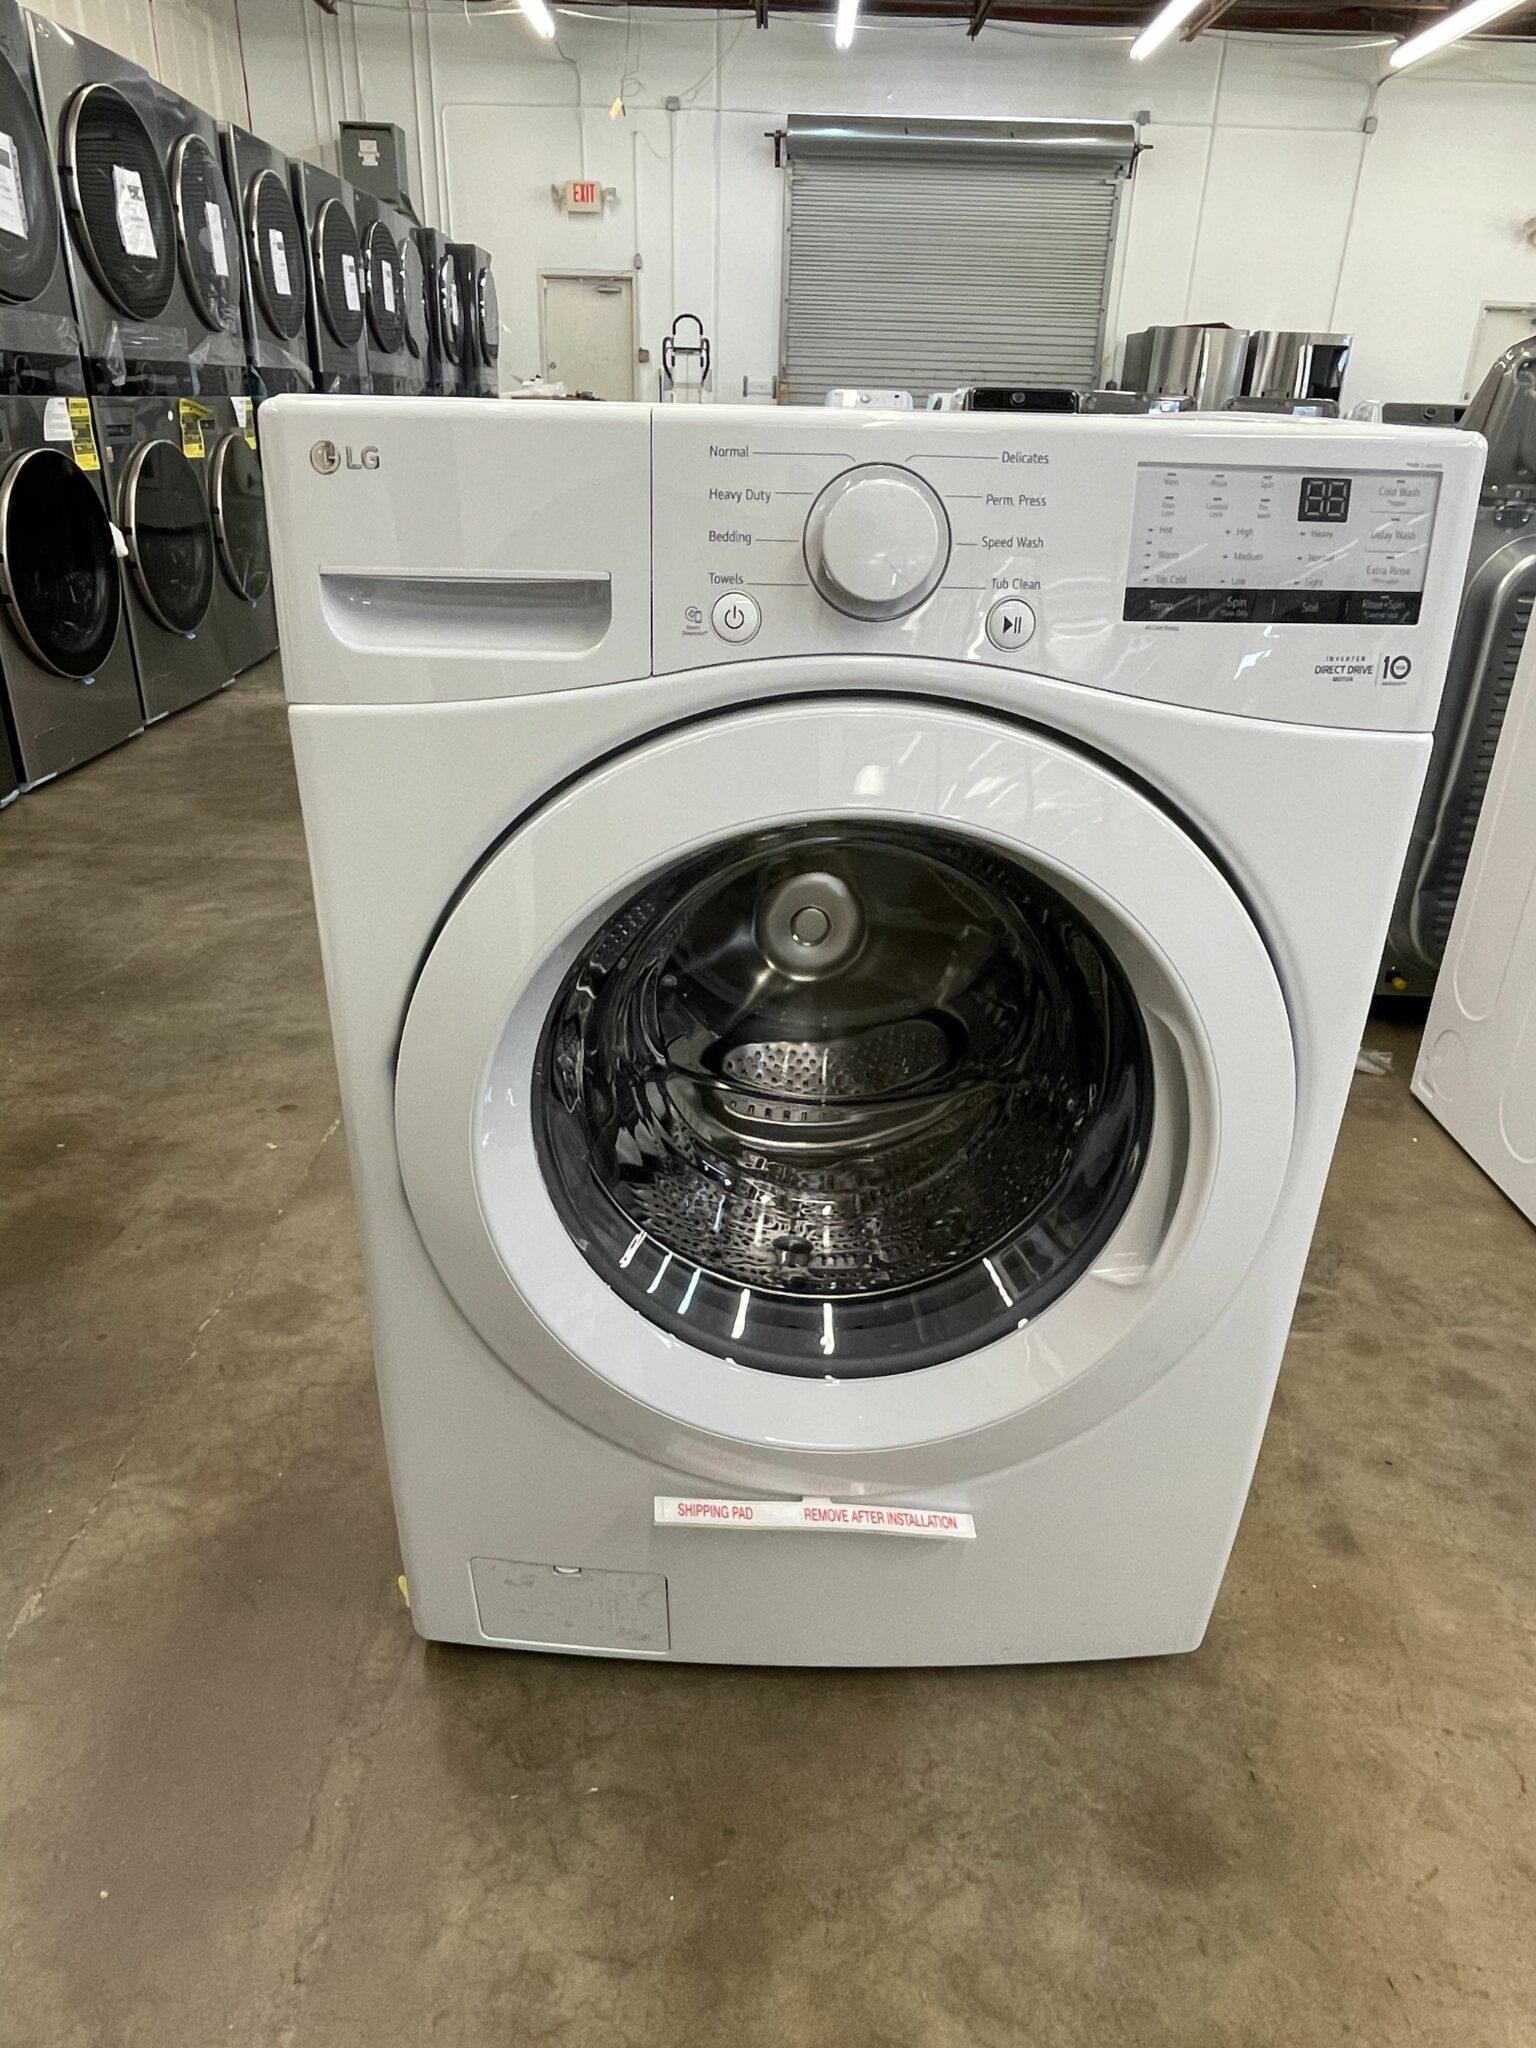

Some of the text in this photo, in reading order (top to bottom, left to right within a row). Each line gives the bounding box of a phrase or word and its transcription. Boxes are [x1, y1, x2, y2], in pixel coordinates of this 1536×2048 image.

[573, 183, 595, 203] EXIT
[345, 445, 380, 470] LG
[709, 445, 750, 458] Normal
[1001, 451, 1049, 464] Delicates
[709, 488, 771, 504] Heavy Duty
[1378, 487, 1397, 497] Cold
[986, 493, 1047, 507] Perm. Press
[709, 530, 752, 545] Bedding
[1236, 527, 1254, 538] High
[1396, 530, 1417, 540] Wash
[982, 536, 1044, 550] Speed Wash
[1157, 551, 1180, 560] Warm
[1234, 551, 1264, 561] Medium
[1366, 565, 1387, 576] Extra
[709, 572, 744, 585] Towels
[992, 577, 1041, 590] Tub Clean
[1231, 577, 1246, 586] Low
[1226, 596, 1247, 608] Spin
[1301, 602, 1319, 613] Soil
[1314, 664, 1374, 675] DIRECT DRIVE
[1382, 655, 1412, 680] 10
[677, 1502, 753, 1520] SHIPPING PAD
[804, 1507, 957, 1529] REMOVE AFTER INSTALLATION
